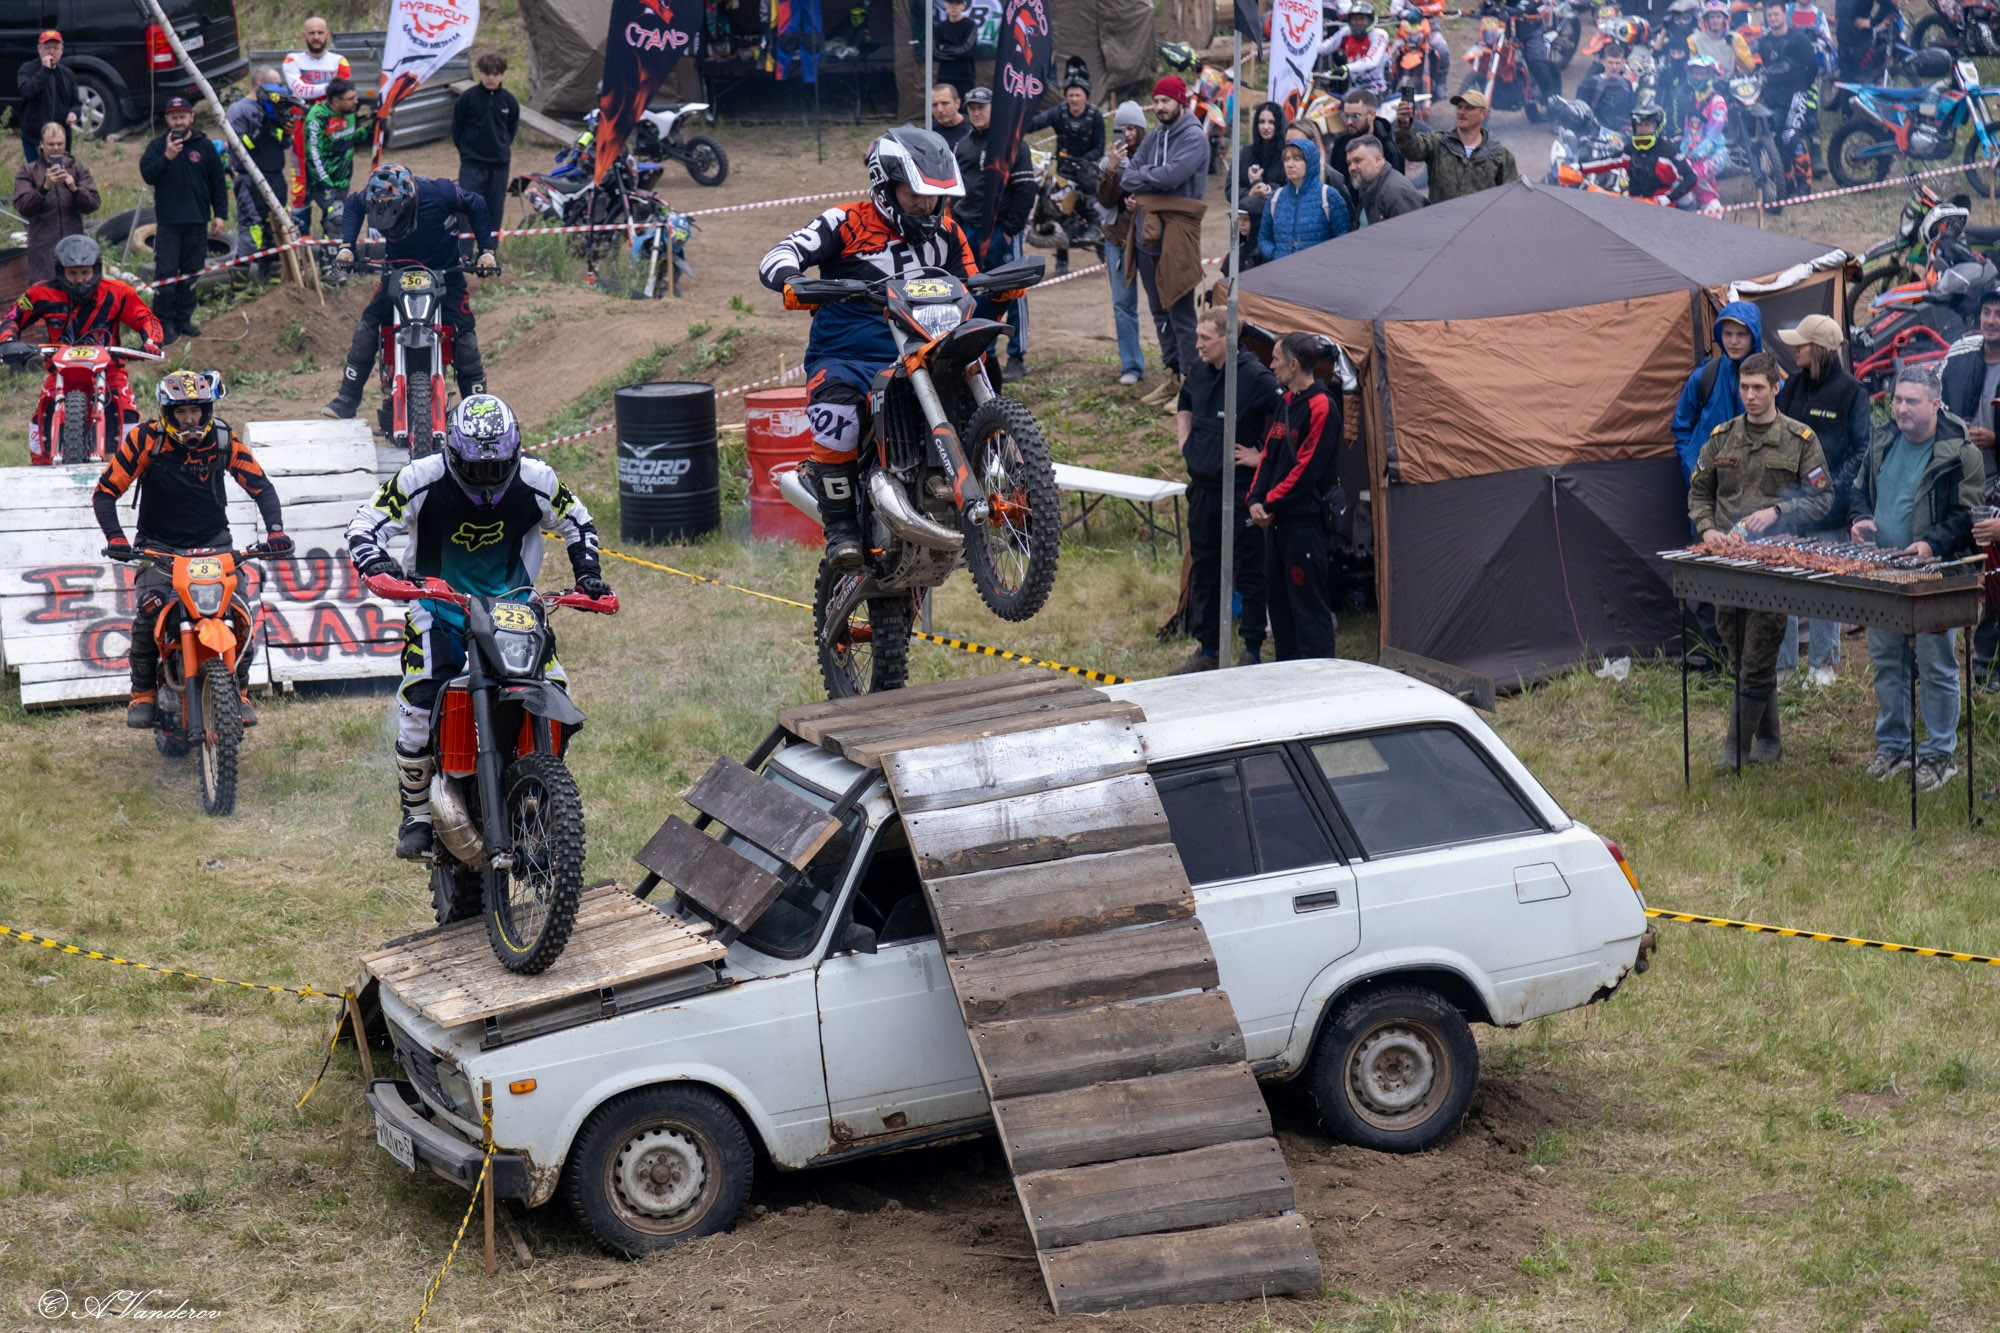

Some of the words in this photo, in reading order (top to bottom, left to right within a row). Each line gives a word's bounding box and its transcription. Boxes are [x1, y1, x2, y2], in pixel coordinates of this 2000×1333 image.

[400, 1, 470, 24] HYPERCUT
[407, 276, 421, 286] 50
[918, 284, 939, 293] 24
[935, 438, 955, 476] CHAMP
[641, 476, 679, 485] RADIO
[632, 485, 653, 493] 104.4
[201, 565, 209, 574] 8
[505, 610, 525, 625] 23
